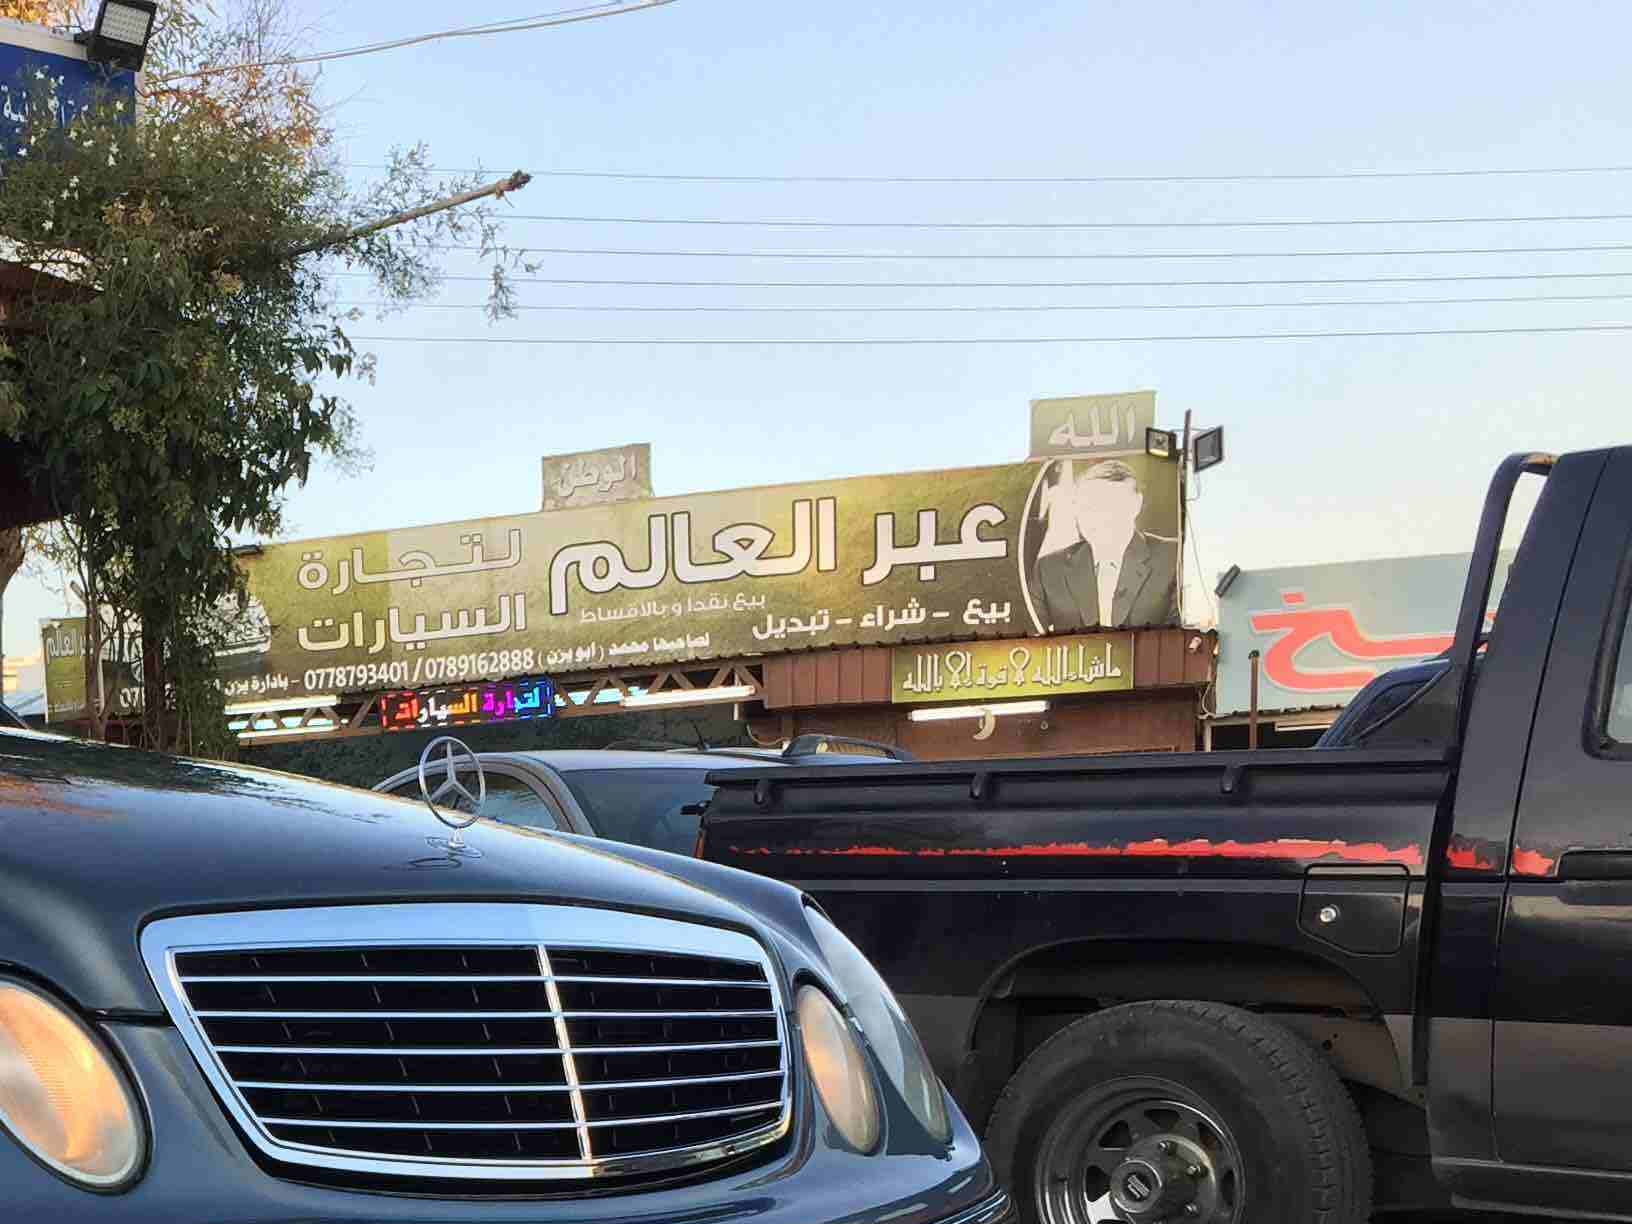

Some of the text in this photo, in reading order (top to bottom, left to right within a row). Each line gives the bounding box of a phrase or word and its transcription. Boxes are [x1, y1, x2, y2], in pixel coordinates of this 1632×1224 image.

[1048, 400, 1136, 447] الله
[296, 527, 524, 597] لتجارة
[549, 495, 1009, 617] عبر العالم
[296, 592, 528, 654] السيارات
[751, 607, 831, 642] تبديل
[859, 596, 927, 632] شراء
[962, 597, 1012, 626] بيع
[303, 660, 409, 691] 0778793401
[424, 648, 535, 680] 0789162888
